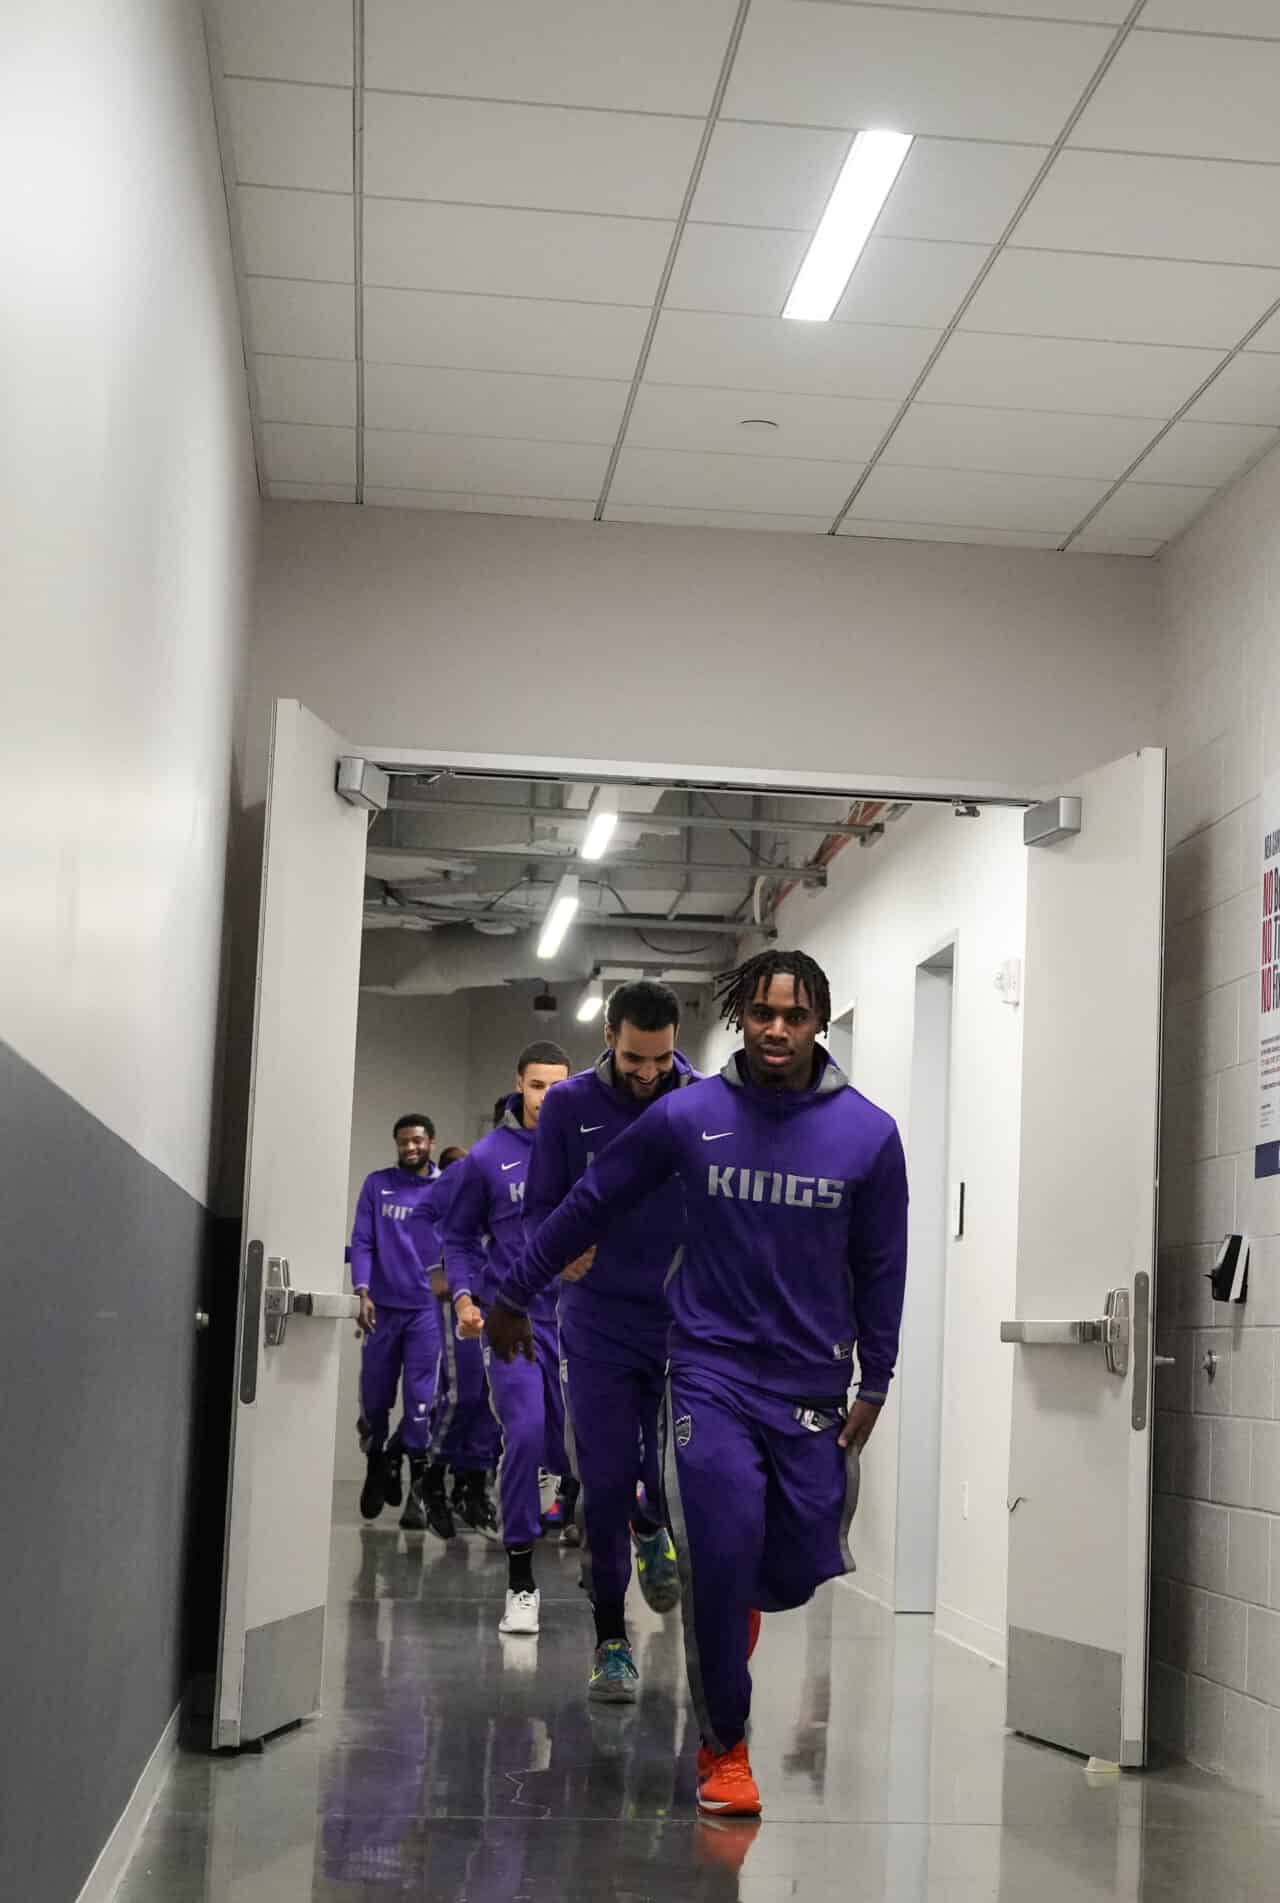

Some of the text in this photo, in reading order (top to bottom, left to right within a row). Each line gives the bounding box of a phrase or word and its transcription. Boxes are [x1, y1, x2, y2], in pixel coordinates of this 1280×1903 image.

[1263, 869, 1273, 917] NO
[1262, 918, 1272, 965] NO
[1261, 966, 1272, 1013] NO
[708, 1164, 845, 1208] KINGS
